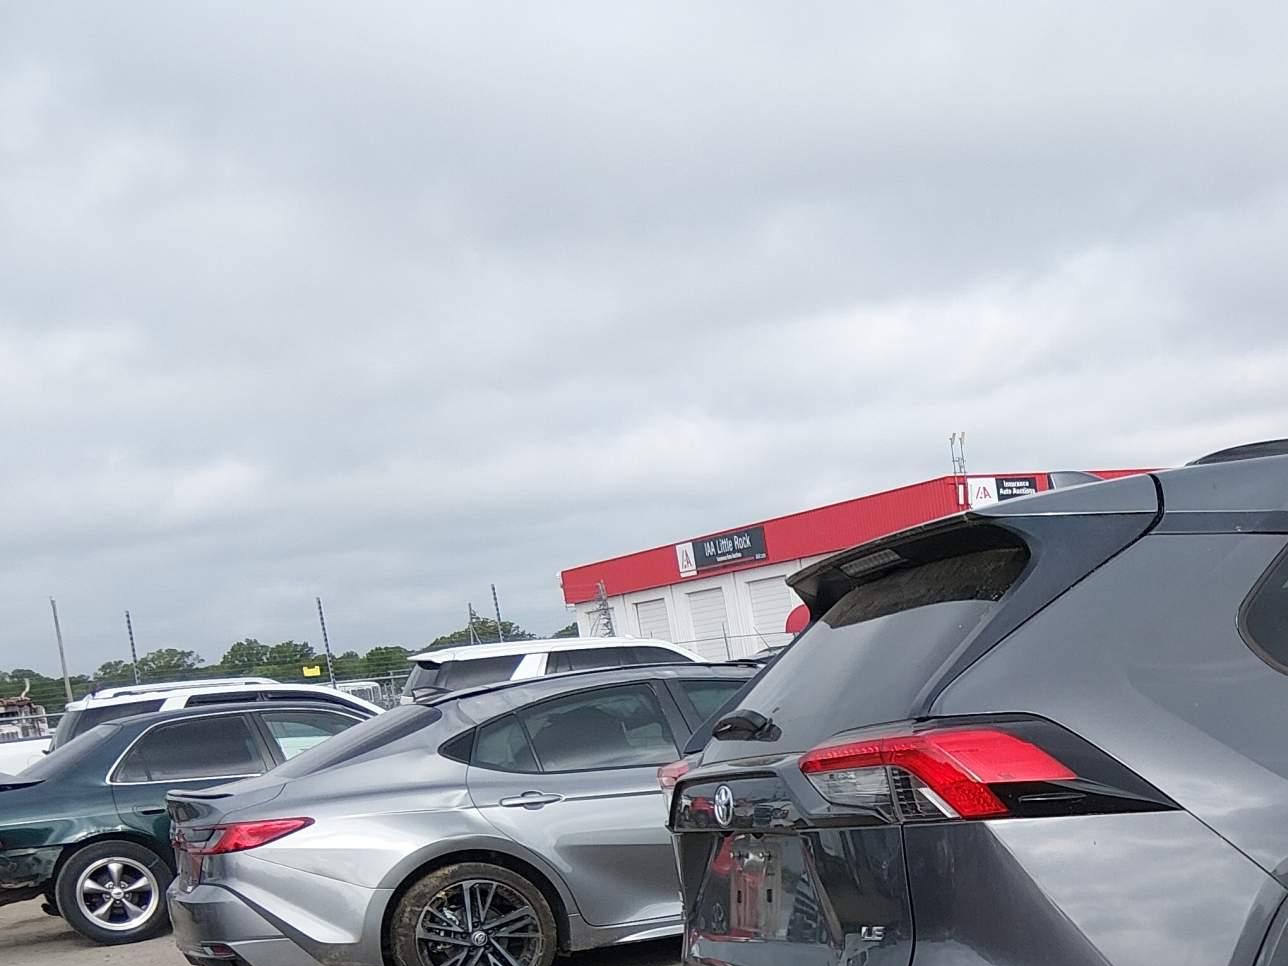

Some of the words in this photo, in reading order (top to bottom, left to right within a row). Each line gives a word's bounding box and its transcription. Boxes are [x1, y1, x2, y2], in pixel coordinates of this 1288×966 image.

[999, 487, 1011, 495] Auto
[703, 541, 717, 557] IAA
[716, 537, 733, 554] Little
[733, 533, 752, 550] Rock
[861, 926, 886, 941] LE
